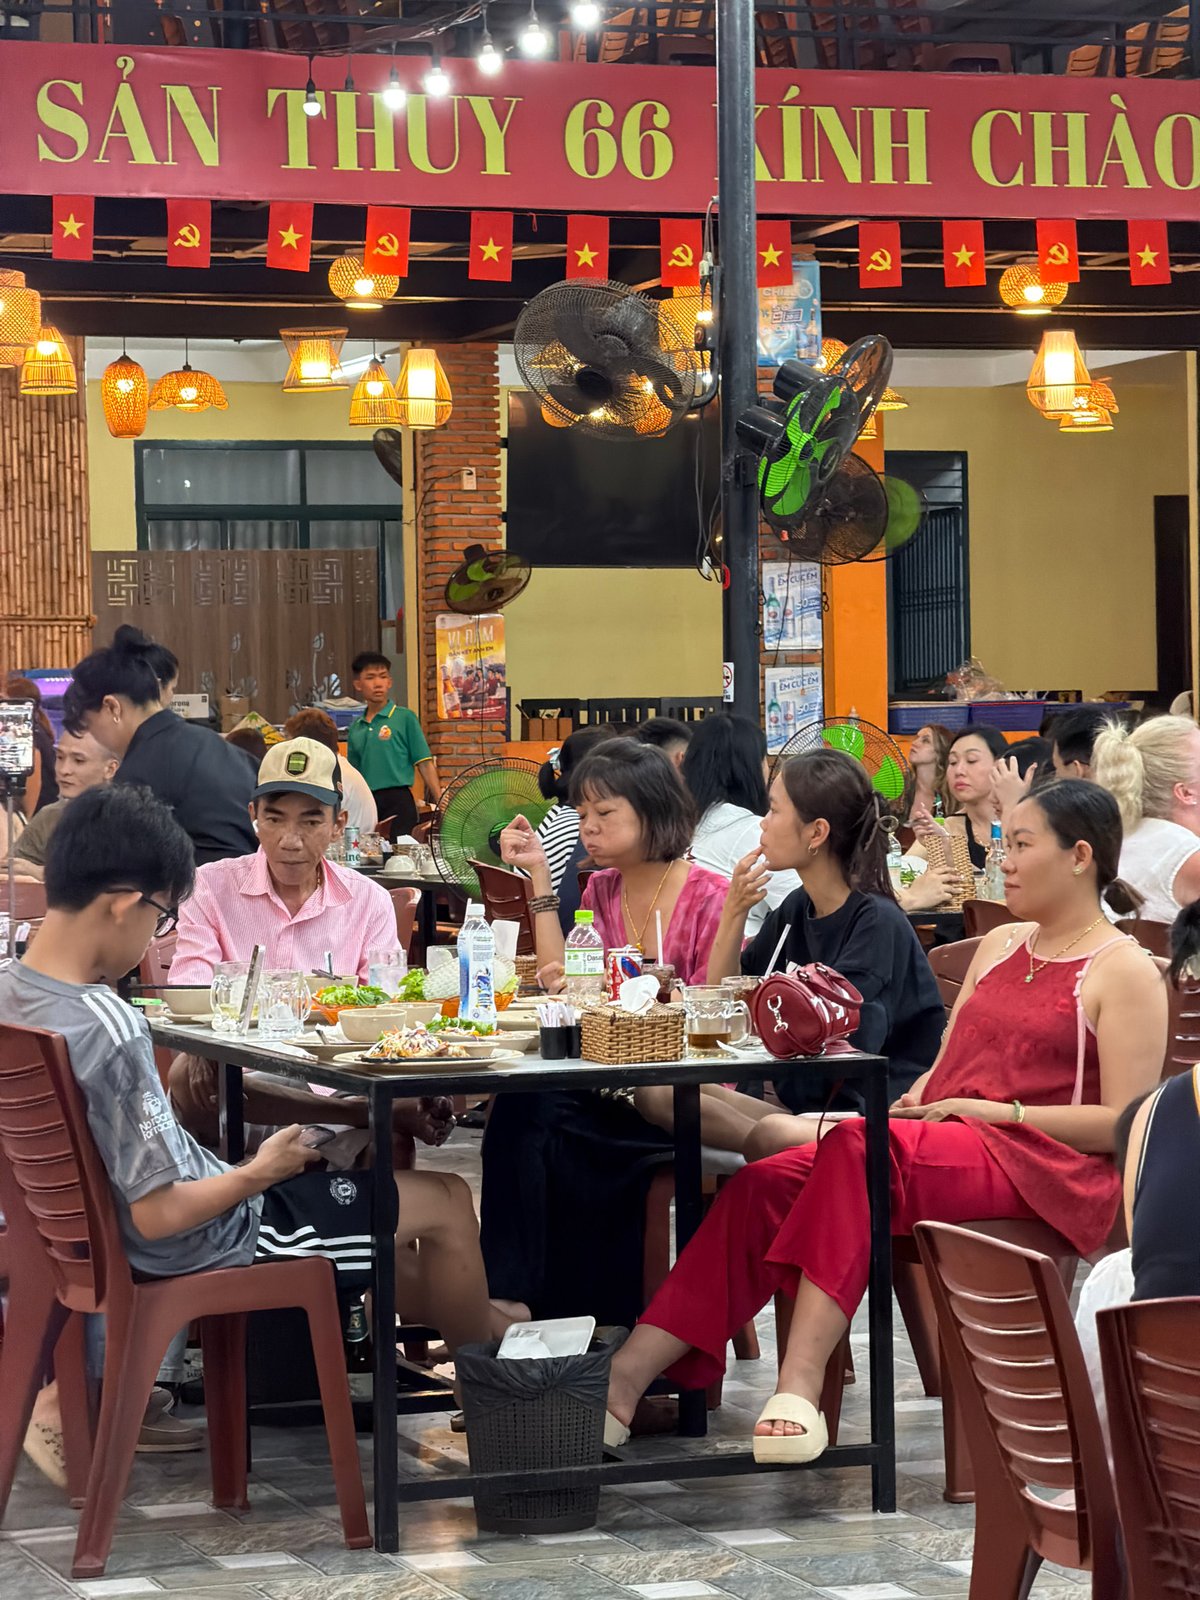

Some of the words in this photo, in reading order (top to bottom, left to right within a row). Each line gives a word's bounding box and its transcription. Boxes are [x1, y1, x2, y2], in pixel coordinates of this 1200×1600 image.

[36, 57, 222, 167] SẢN
[564, 98, 675, 182] 66
[970, 94, 1200, 191] CHÀO
[138, 1120, 152, 1132] No
[143, 1128, 155, 1141] for
